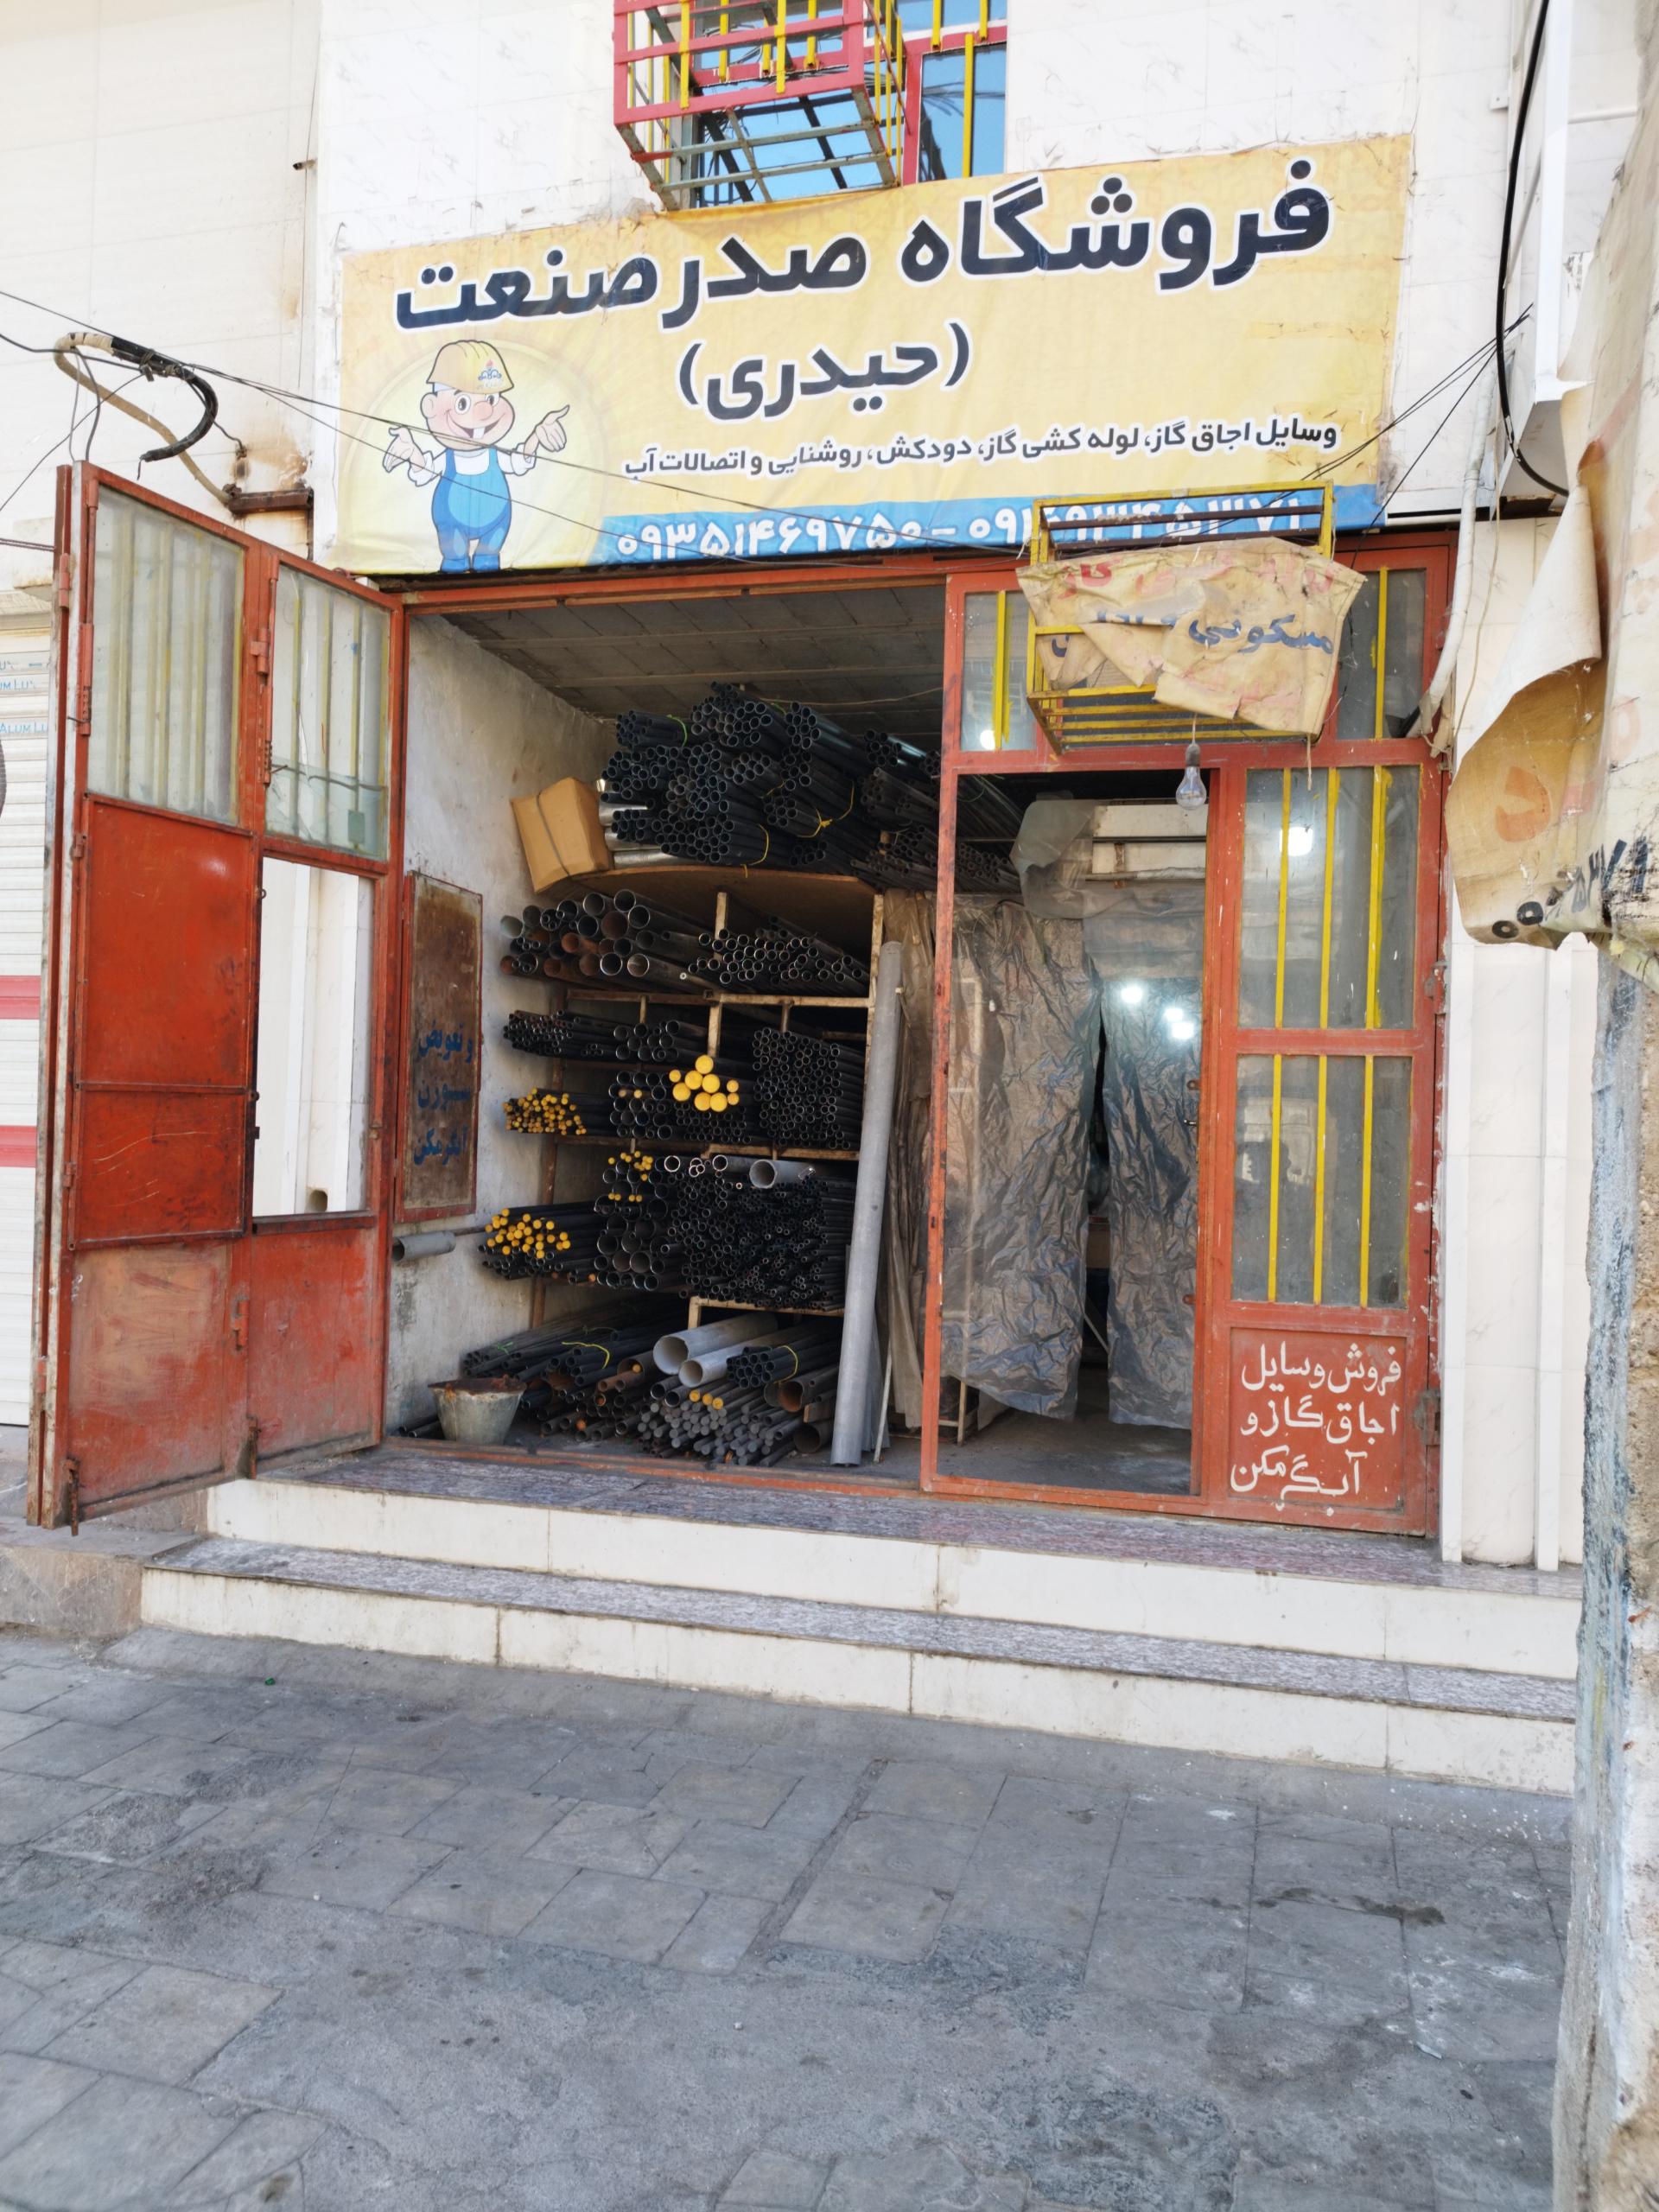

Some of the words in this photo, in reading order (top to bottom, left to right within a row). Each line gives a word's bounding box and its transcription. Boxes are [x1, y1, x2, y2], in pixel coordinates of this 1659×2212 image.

[900, 160, 1331, 290] فروشگاه
[396, 249, 658, 329] صنعت
[662, 235, 868, 328] صدر
[679, 322, 969, 420] (حیدری)
[1023, 428, 1080, 458] کشی
[1088, 428, 1139, 454] لوله
[1192, 423, 1250, 451] اجاق
[1256, 418, 1337, 448] وسایل
[625, 448, 658, 478] آب
[659, 450, 745, 471] اتصالات
[750, 455, 762, 475] و
[769, 440, 861, 475] روشنایی
[617, 512, 922, 560] ۰۹۳۵۱۴۶۹۷۵۰
[1241, 1340, 1325, 1393] وسایل
[1327, 1343, 1402, 1396] فروش
[1260, 1395, 1325, 1437] گاز
[1325, 1401, 1400, 1445] اجاق
